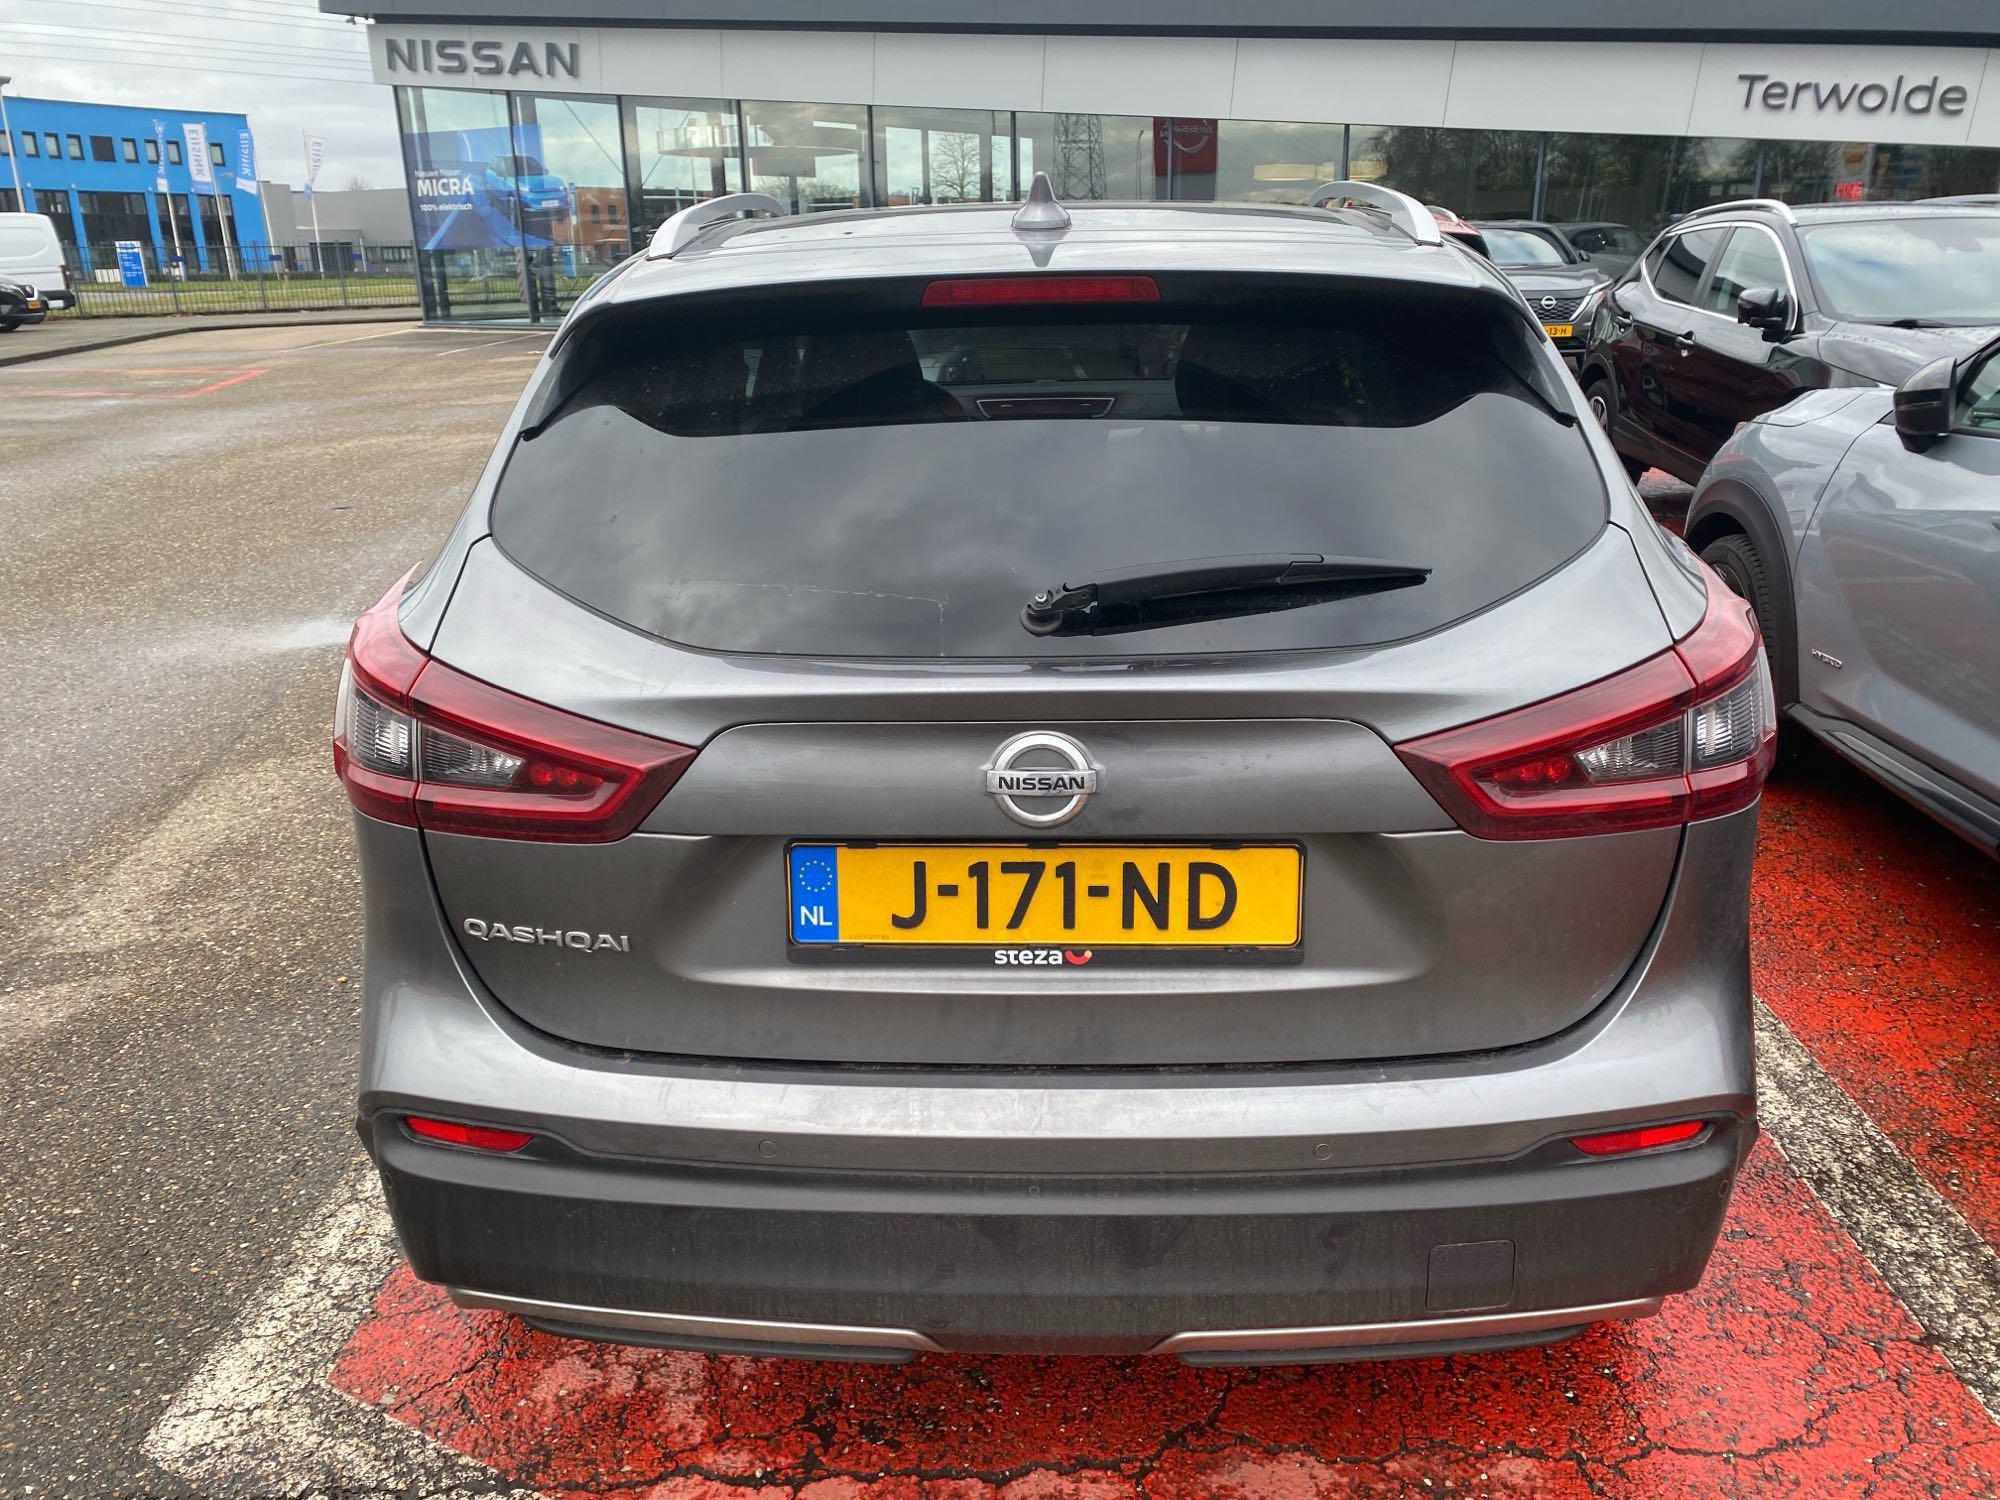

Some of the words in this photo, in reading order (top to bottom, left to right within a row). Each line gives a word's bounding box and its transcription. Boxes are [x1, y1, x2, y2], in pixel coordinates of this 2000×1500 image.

[384, 38, 579, 78] NISSAN
[1738, 73, 1968, 115] Terwolde
[417, 178, 475, 197] MICRA
[998, 776, 1085, 791] NISSAN
[891, 861, 1238, 931] J-171-ND
[800, 905, 833, 926] NL
[463, 918, 631, 953] QASHQAI
[994, 949, 1063, 965] steza
